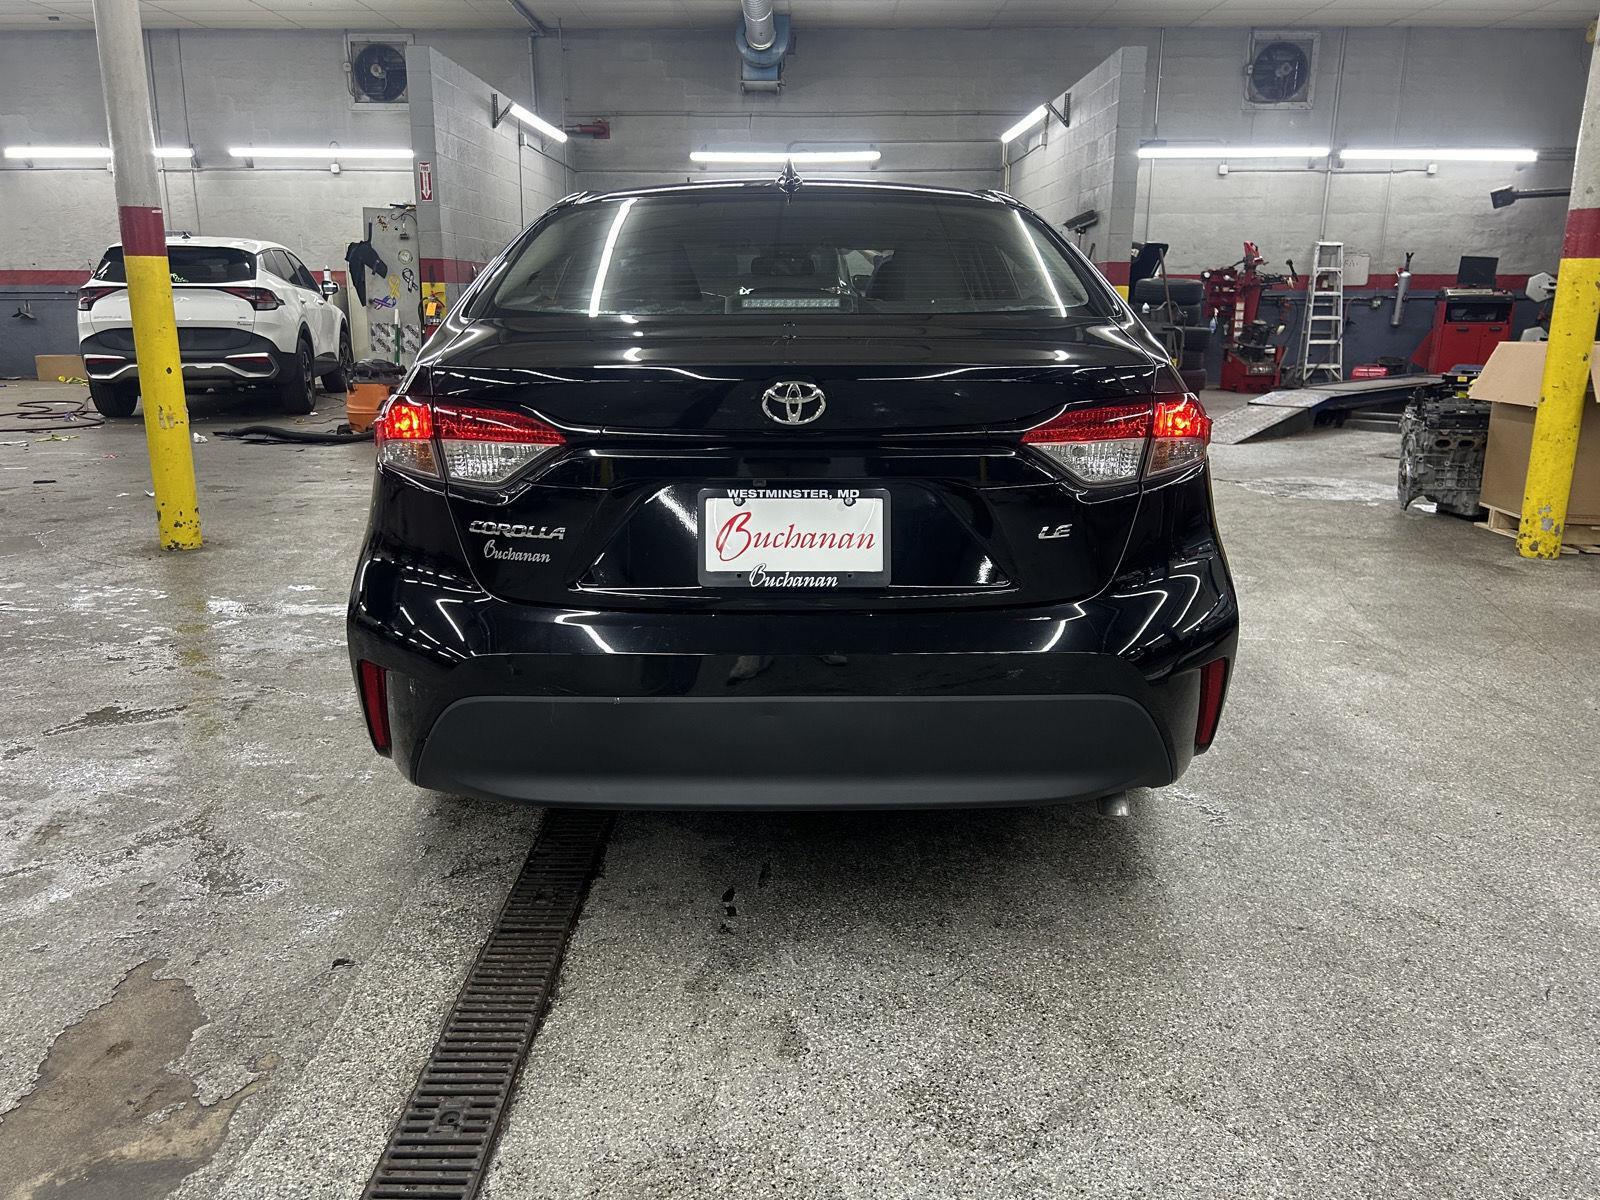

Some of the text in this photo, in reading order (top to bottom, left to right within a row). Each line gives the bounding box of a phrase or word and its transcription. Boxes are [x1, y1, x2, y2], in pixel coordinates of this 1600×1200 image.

[727, 489, 860, 500] WESTMINSTER, MD
[469, 520, 566, 540] COROLLA
[716, 511, 875, 561] Buchanan
[1038, 523, 1073, 539] LE
[483, 539, 551, 563] Buchanan
[749, 563, 838, 587] Buchanan
